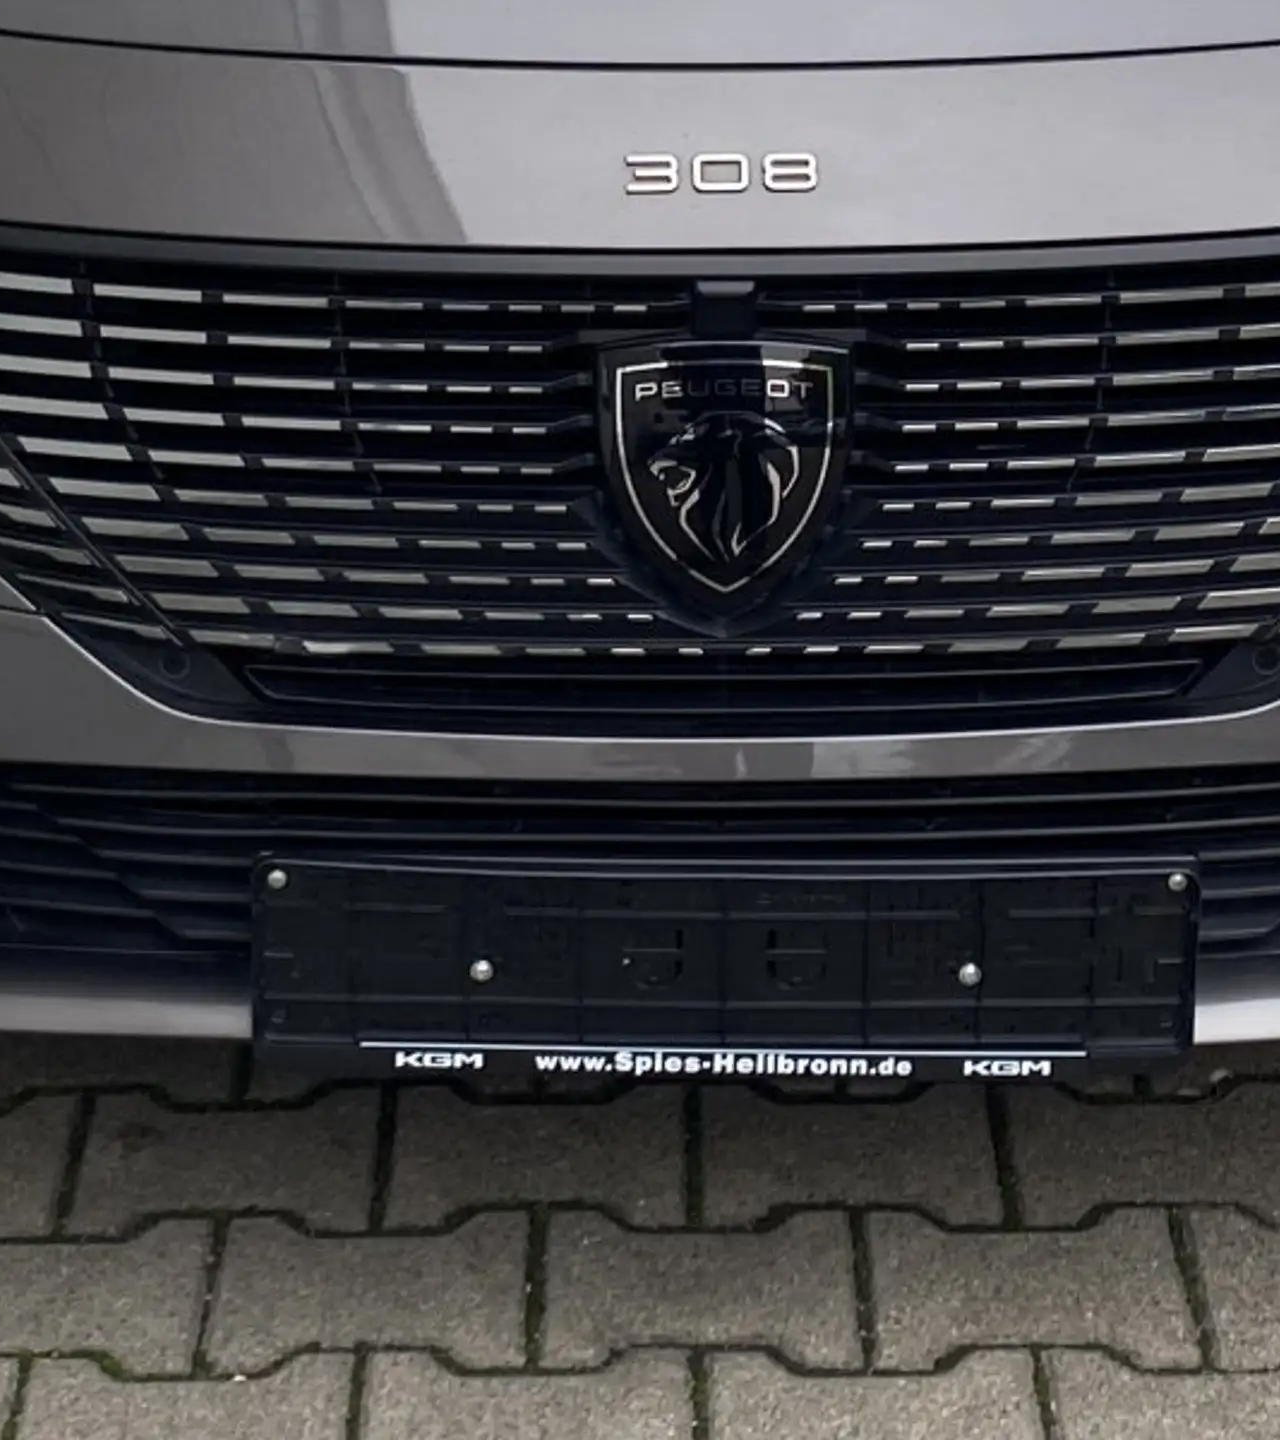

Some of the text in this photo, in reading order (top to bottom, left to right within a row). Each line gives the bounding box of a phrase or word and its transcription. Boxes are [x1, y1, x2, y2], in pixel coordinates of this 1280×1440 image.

[625, 152, 818, 193] 308
[635, 379, 814, 401] PEUGEOT
[395, 1051, 1052, 1077] KGM www.Spies-Heilbronn.de KGM
